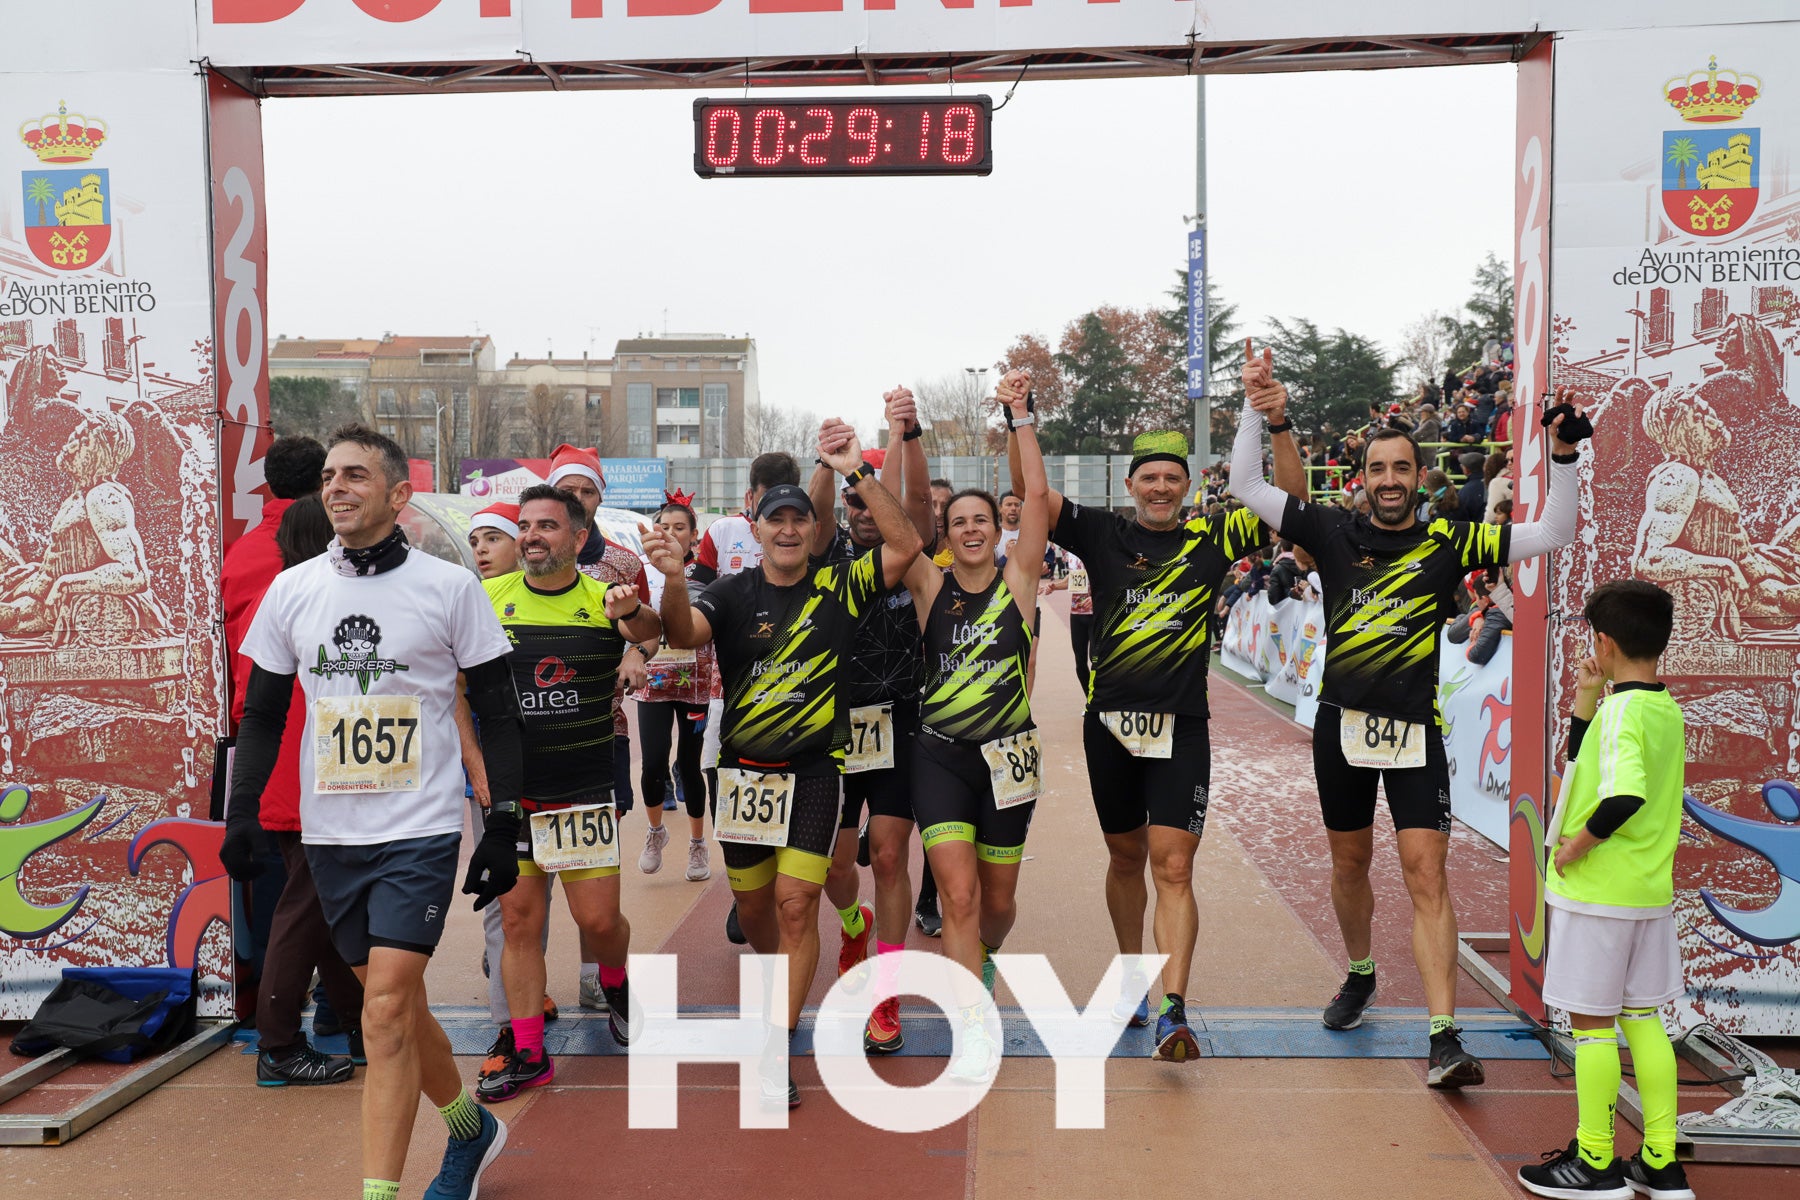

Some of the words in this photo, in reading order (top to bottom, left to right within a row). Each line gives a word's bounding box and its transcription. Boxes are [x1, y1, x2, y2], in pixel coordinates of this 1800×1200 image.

[707, 106, 977, 166] 00:29:18
[1638, 245, 1800, 273] Ayuntamiento
[1711, 260, 1800, 283] BENITO
[7, 279, 152, 303] Ayuntamiento
[74, 293, 156, 314] BENITO
[952, 620, 998, 645] LÓPEZ
[321, 660, 395, 672] AXOBIKERS
[939, 652, 1010, 673] Bálamo
[521, 689, 580, 709] area
[1120, 711, 1165, 739] 860
[1364, 715, 1411, 749] 847
[332, 717, 418, 765] 1657
[327, 783, 378, 791] DOMBENITENSE
[729, 785, 789, 825] 1351
[549, 811, 614, 850] 1150
